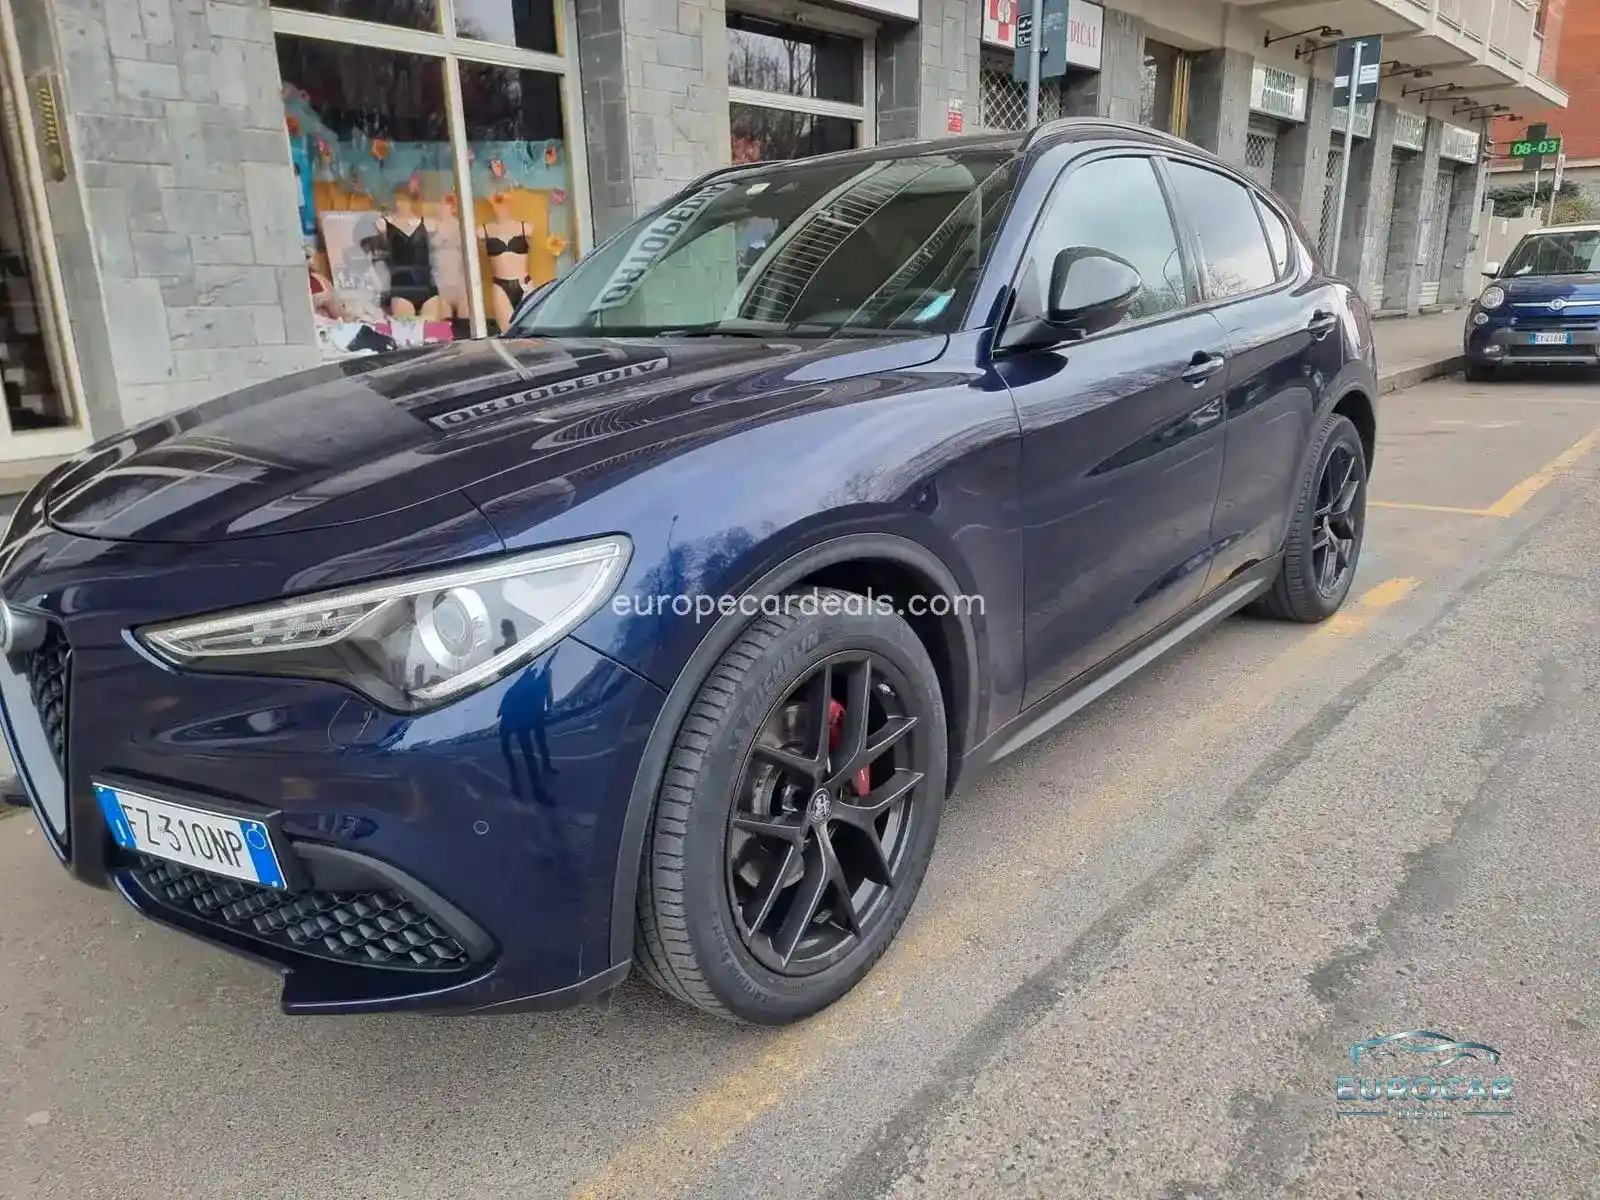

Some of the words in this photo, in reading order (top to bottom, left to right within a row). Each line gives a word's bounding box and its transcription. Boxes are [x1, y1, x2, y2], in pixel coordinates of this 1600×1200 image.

[1069, 20, 1097, 48] DICAL
[1513, 140, 1558, 156] 08-03
[121, 804, 243, 868] FZ310NP
